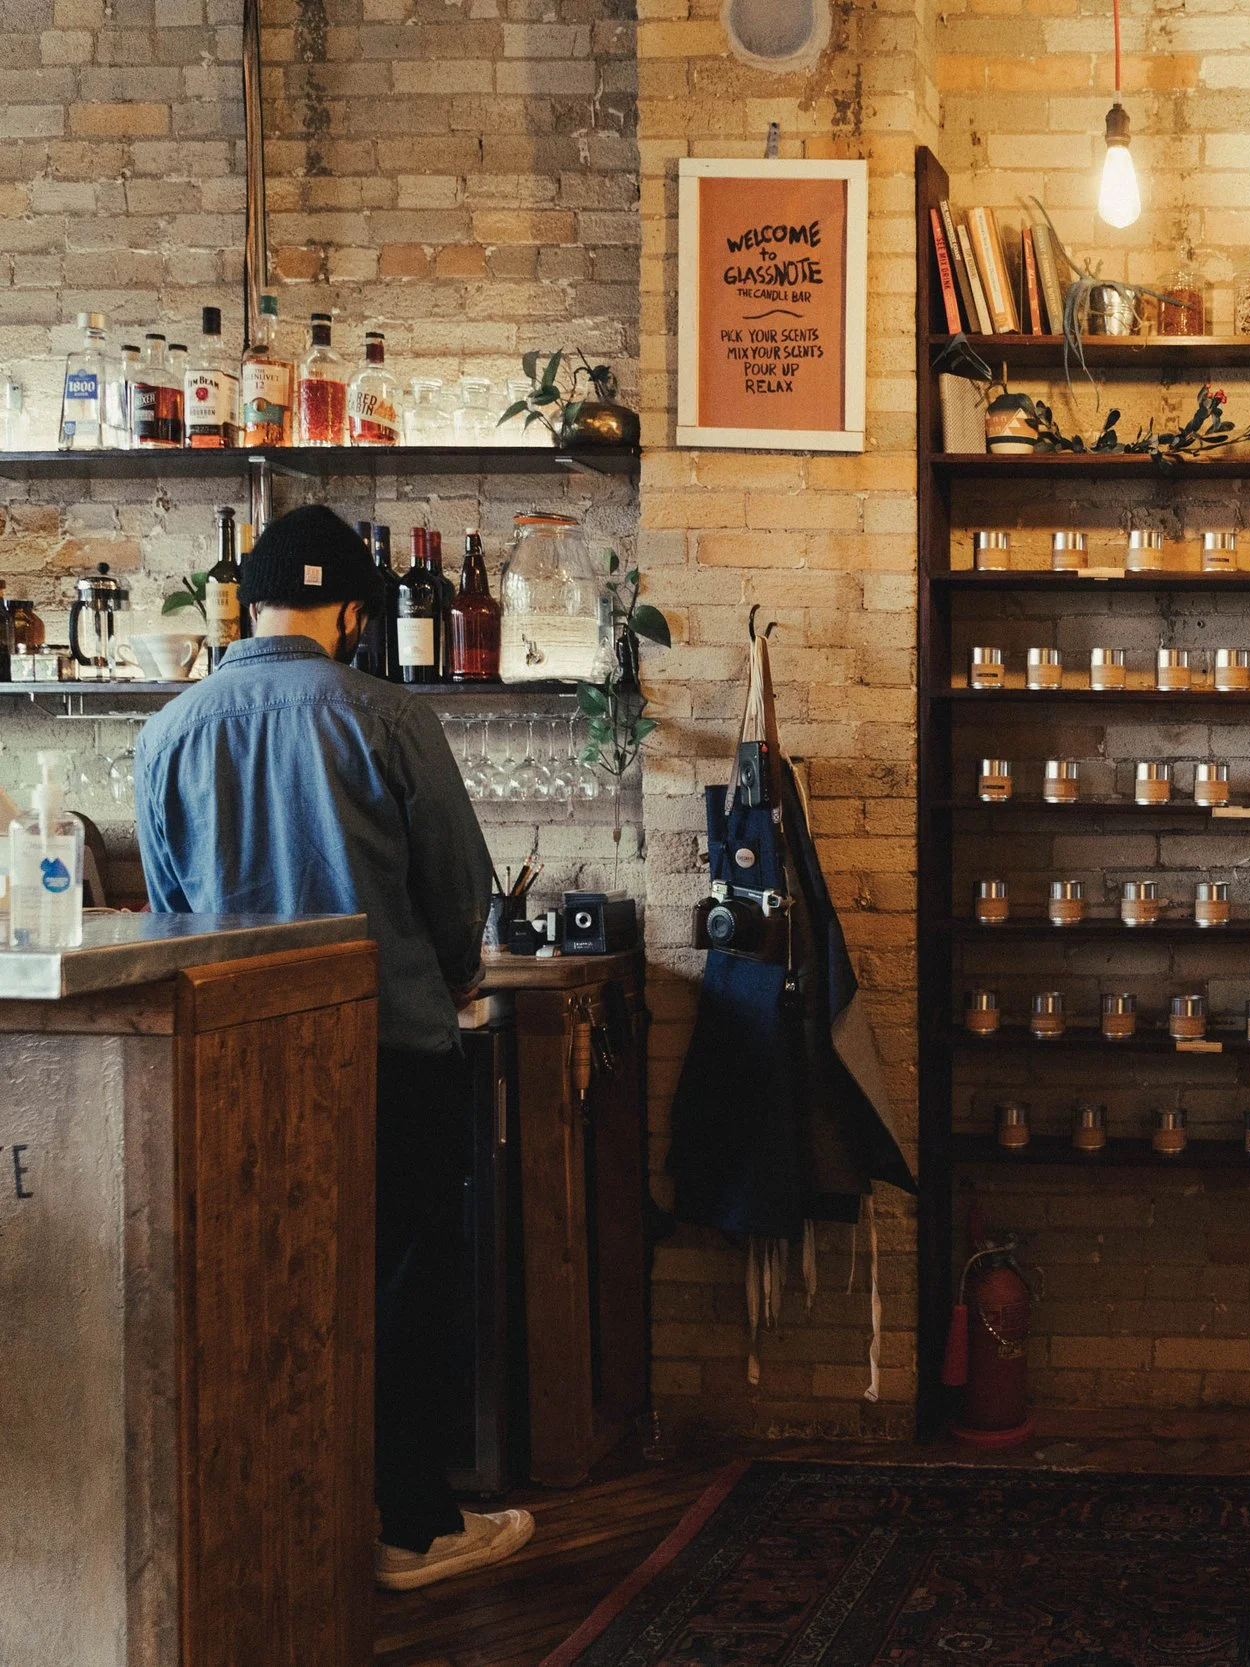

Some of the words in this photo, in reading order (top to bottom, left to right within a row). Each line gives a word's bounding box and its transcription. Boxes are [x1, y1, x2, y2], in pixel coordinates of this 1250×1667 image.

[727, 220, 821, 253] WELCOME
[936, 238, 945, 251] SEE
[760, 247, 777, 261] to
[939, 252, 947, 266] MIX
[723, 257, 823, 287] GLASSNOTE
[941, 267, 950, 290] DRINK
[737, 288, 752, 298] THE
[753, 289, 788, 302] CANDLE
[791, 291, 811, 303] BAR
[720, 329, 743, 343] PICK
[748, 329, 777, 344] YOUR
[781, 328, 819, 343] SCENTS
[727, 347, 748, 360] MIX
[751, 346, 780, 360] YOUR
[783, 346, 824, 360] SCENTS
[744, 362, 777, 377] POUR
[782, 363, 800, 377] UP
[69, 381, 96, 393] 1800
[199, 375, 220, 391] BEAM
[255, 381, 265, 390] 12
[745, 379, 794, 395] RELAX
[357, 391, 378, 406] RED
